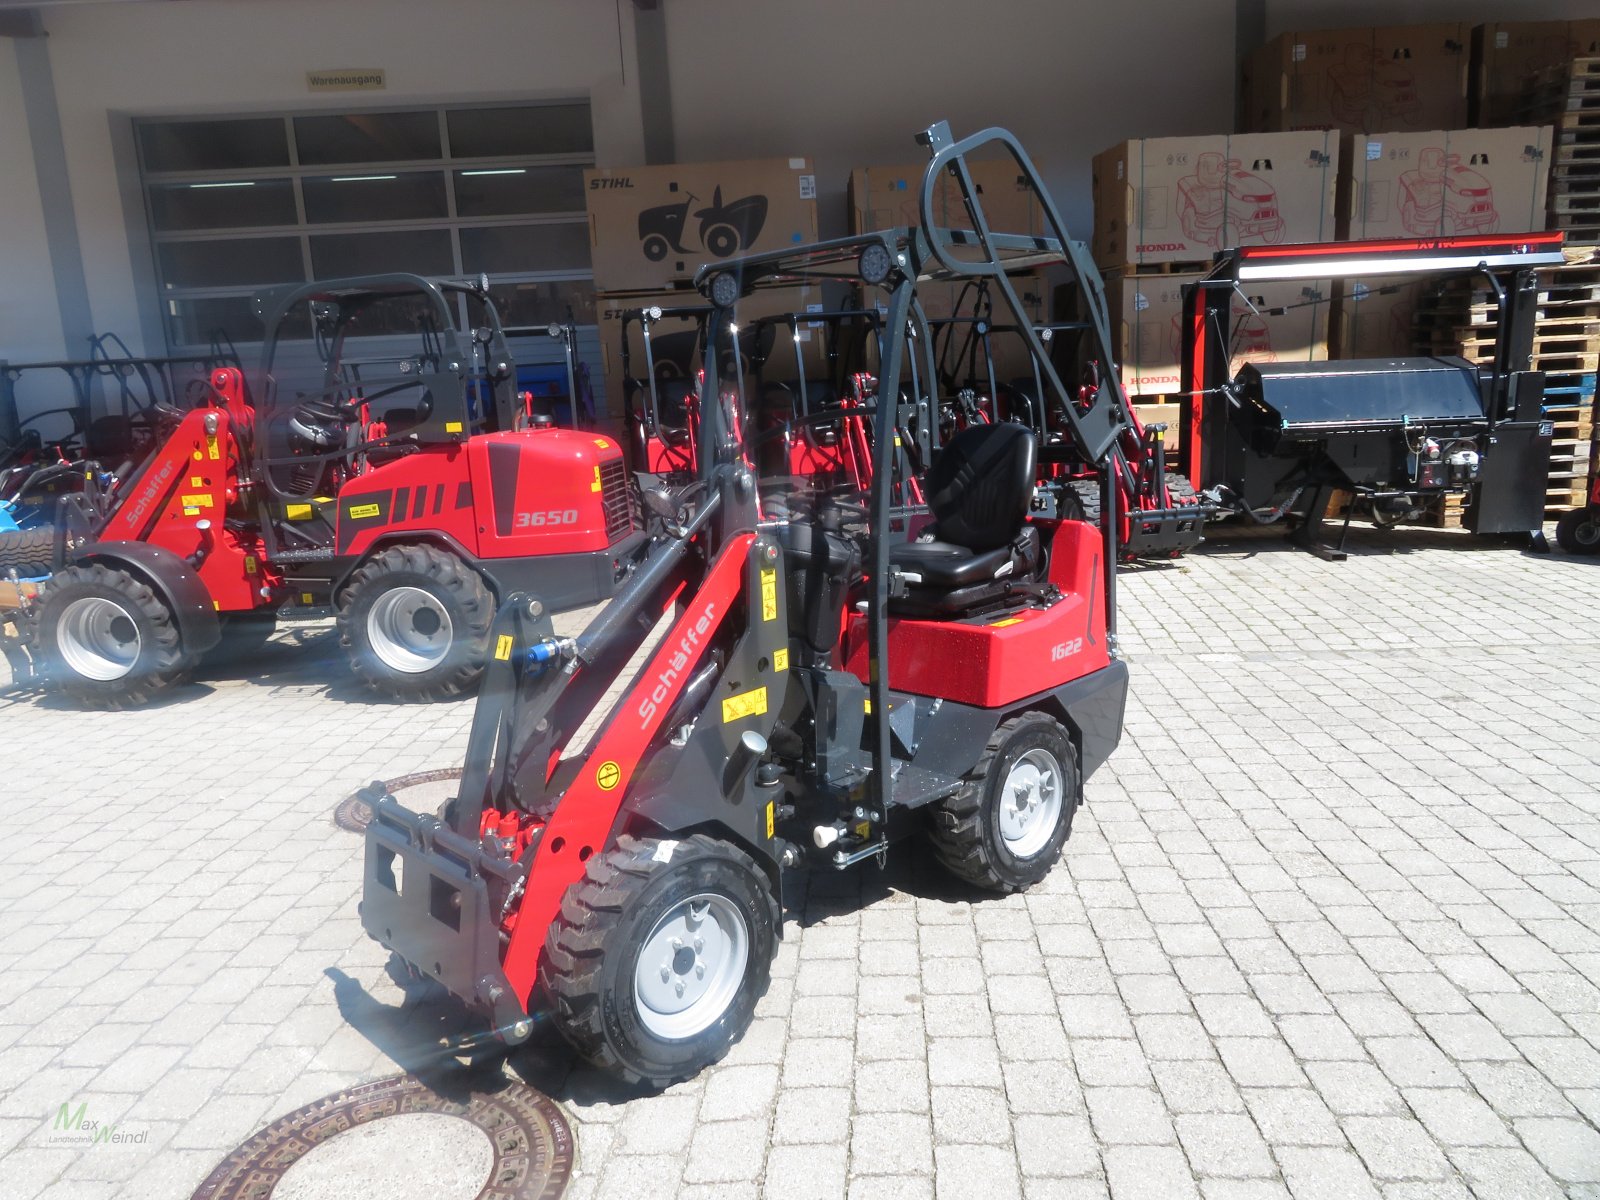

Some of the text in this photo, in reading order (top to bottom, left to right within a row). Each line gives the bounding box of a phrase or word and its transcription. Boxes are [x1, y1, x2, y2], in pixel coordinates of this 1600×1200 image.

[310, 75, 382, 86] Warenausgang
[589, 177, 634, 190] STIHL
[1135, 242, 1186, 253] HONDA
[1129, 375, 1180, 385] HONDA
[125, 460, 173, 529] Schäffer
[515, 509, 578, 528] 3650
[1051, 636, 1083, 662] 1622
[638, 602, 715, 731] Schäffer
